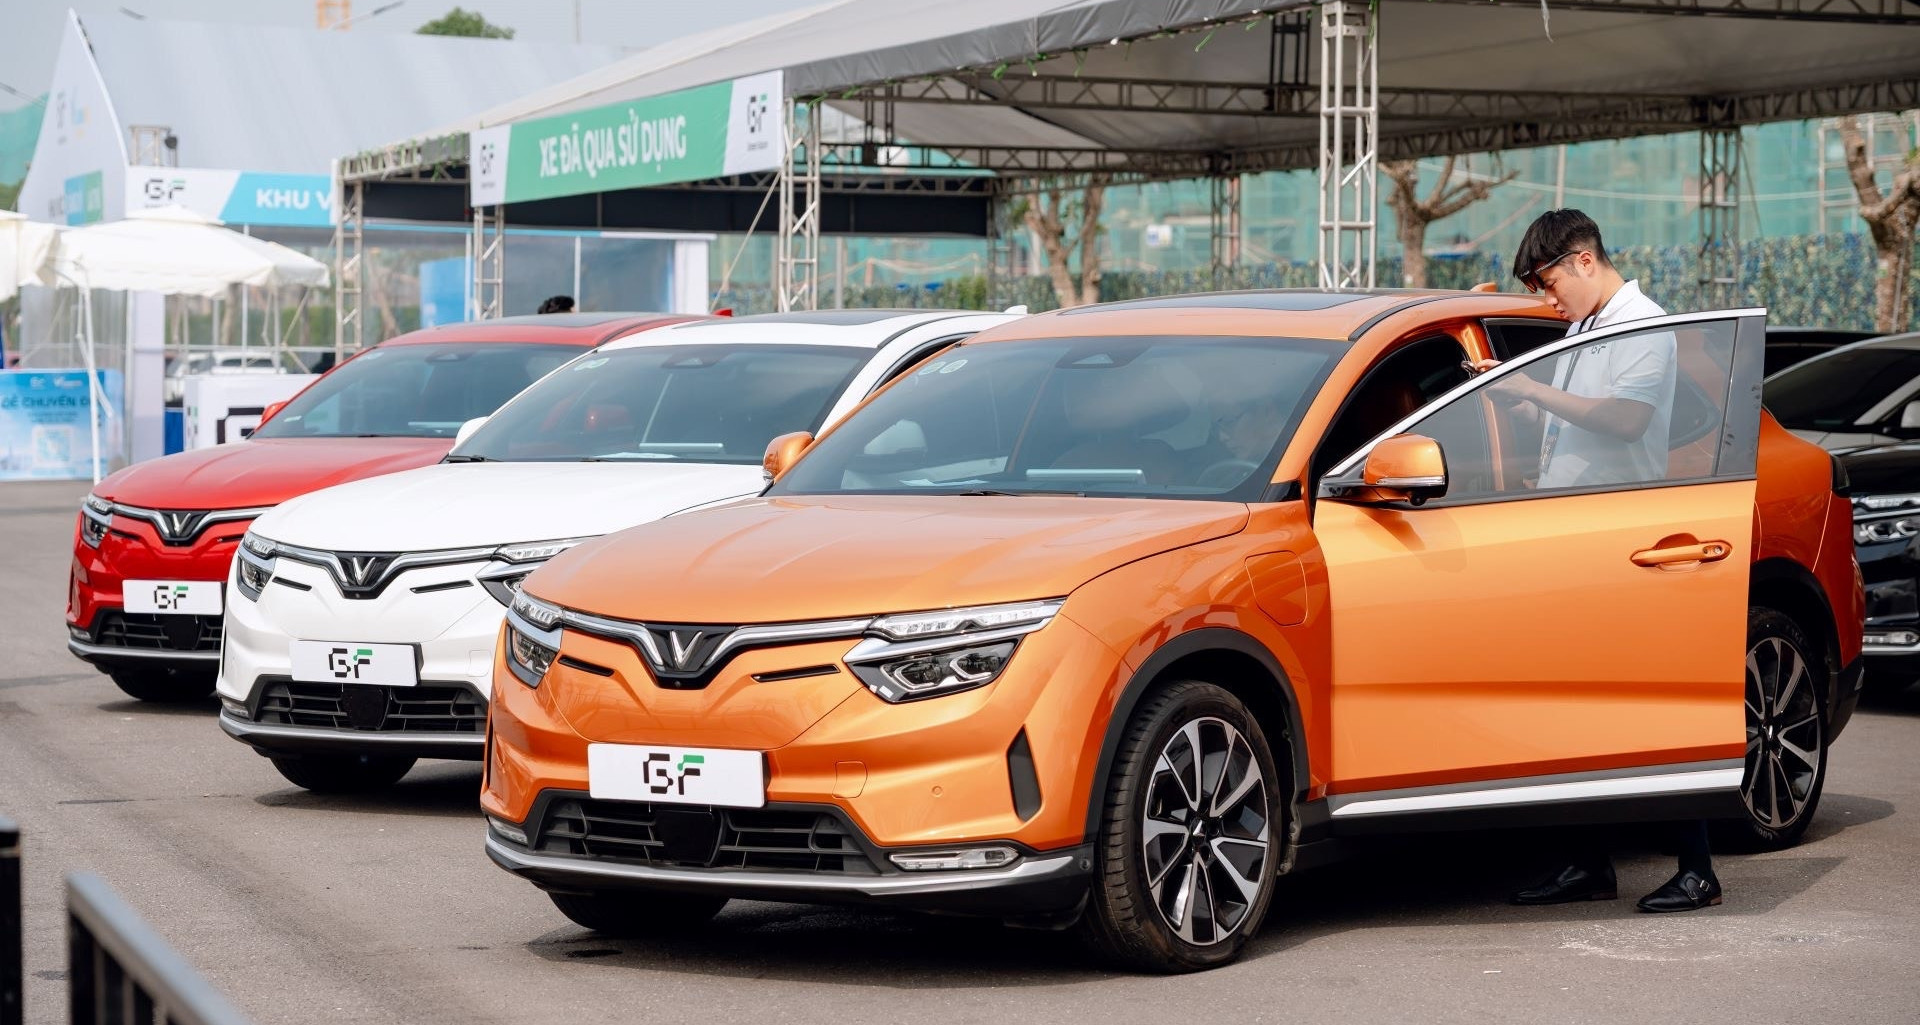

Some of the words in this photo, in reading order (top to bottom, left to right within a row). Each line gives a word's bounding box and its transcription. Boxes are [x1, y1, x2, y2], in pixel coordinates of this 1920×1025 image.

[748, 93, 768, 134] GF
[539, 136, 559, 179] XE
[559, 122, 582, 175] ĐÃ
[583, 127, 617, 179] QUA
[618, 107, 639, 168] SỬ
[640, 115, 687, 173] DỤNG
[145, 178, 186, 200] GF
[256, 188, 310, 210] KHU
[154, 585, 189, 610] GF
[328, 647, 373, 679] GF
[643, 752, 705, 796] GF
